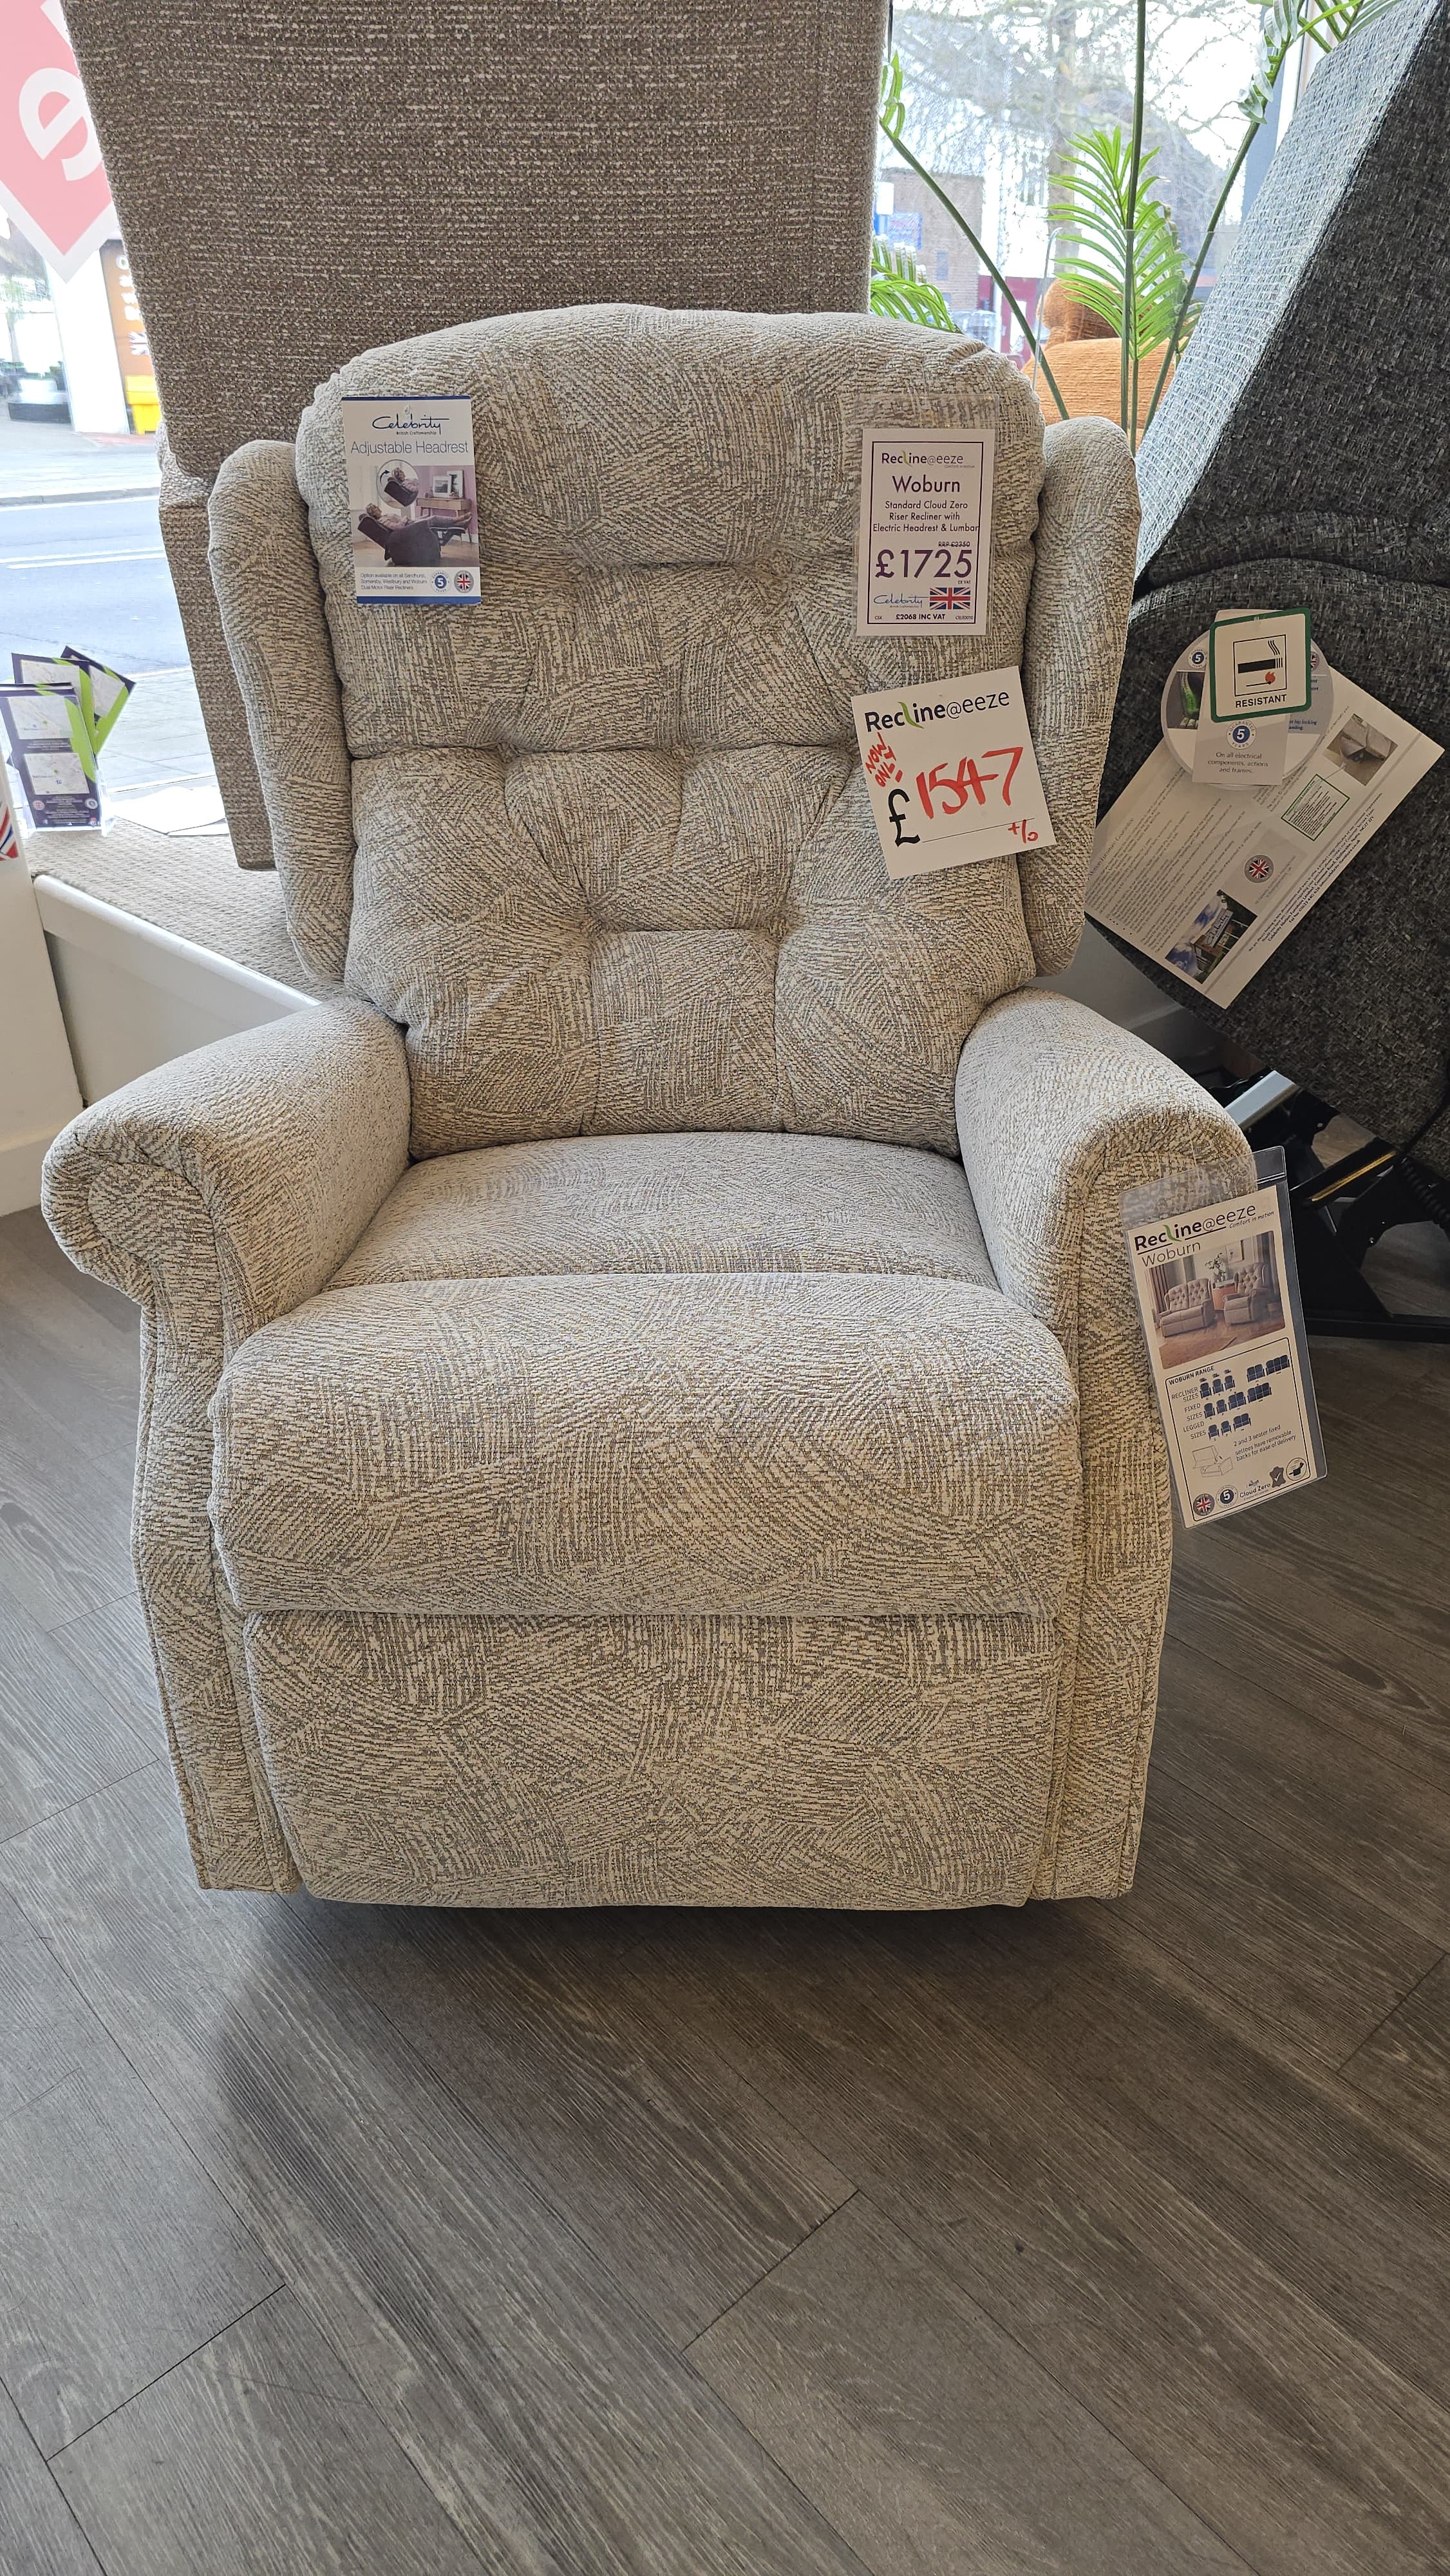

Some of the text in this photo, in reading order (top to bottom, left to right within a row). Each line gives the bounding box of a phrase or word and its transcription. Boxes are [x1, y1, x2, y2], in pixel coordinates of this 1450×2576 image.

[372, 413, 449, 435] Celebrity
[351, 441, 469, 456] Adjustable Headrest
[892, 475, 960, 493] Woburn
[885, 500, 921, 509] Standard
[924, 500, 946, 509] Cloud
[911, 512, 941, 520] Recliner
[945, 512, 959, 520] with
[873, 523, 979, 532] Electric Headrest & Lumbar
[875, 549, 972, 578] £1725
[438, 578, 444, 587] 5
[874, 593, 928, 608] Celebrity
[1236, 694, 1286, 708] RESISTANT
[1237, 728, 1245, 739] 5
[1229, 1218, 1250, 1229] Comfort
[1257, 1211, 1274, 1220] motion
[1142, 1241, 1201, 1267] Woburn
[1169, 1372, 1194, 1385] WOBURN
[1196, 1366, 1215, 1376] RANGE
[1171, 1387, 1198, 1399] RECLINER
[1183, 1393, 1199, 1403] SIZES
[1185, 1403, 1201, 1413] FIXED
[1187, 1412, 1203, 1421] SIZES
[1183, 1421, 1205, 1432] LEGGED
[1253, 1432, 1268, 1440] seater
[1268, 1425, 1281, 1434] fixed
[1191, 1430, 1207, 1440] SIZES
[1235, 1446, 1254, 1455] settees
[1266, 1430, 1292, 1444] removable
[1236, 1453, 1251, 1461] backs
[1277, 1435, 1296, 1446] delivery
[1223, 1490, 1230, 1501] 5
[1239, 1487, 1257, 1498] Cloud
[1257, 1482, 1271, 1492] Zero
